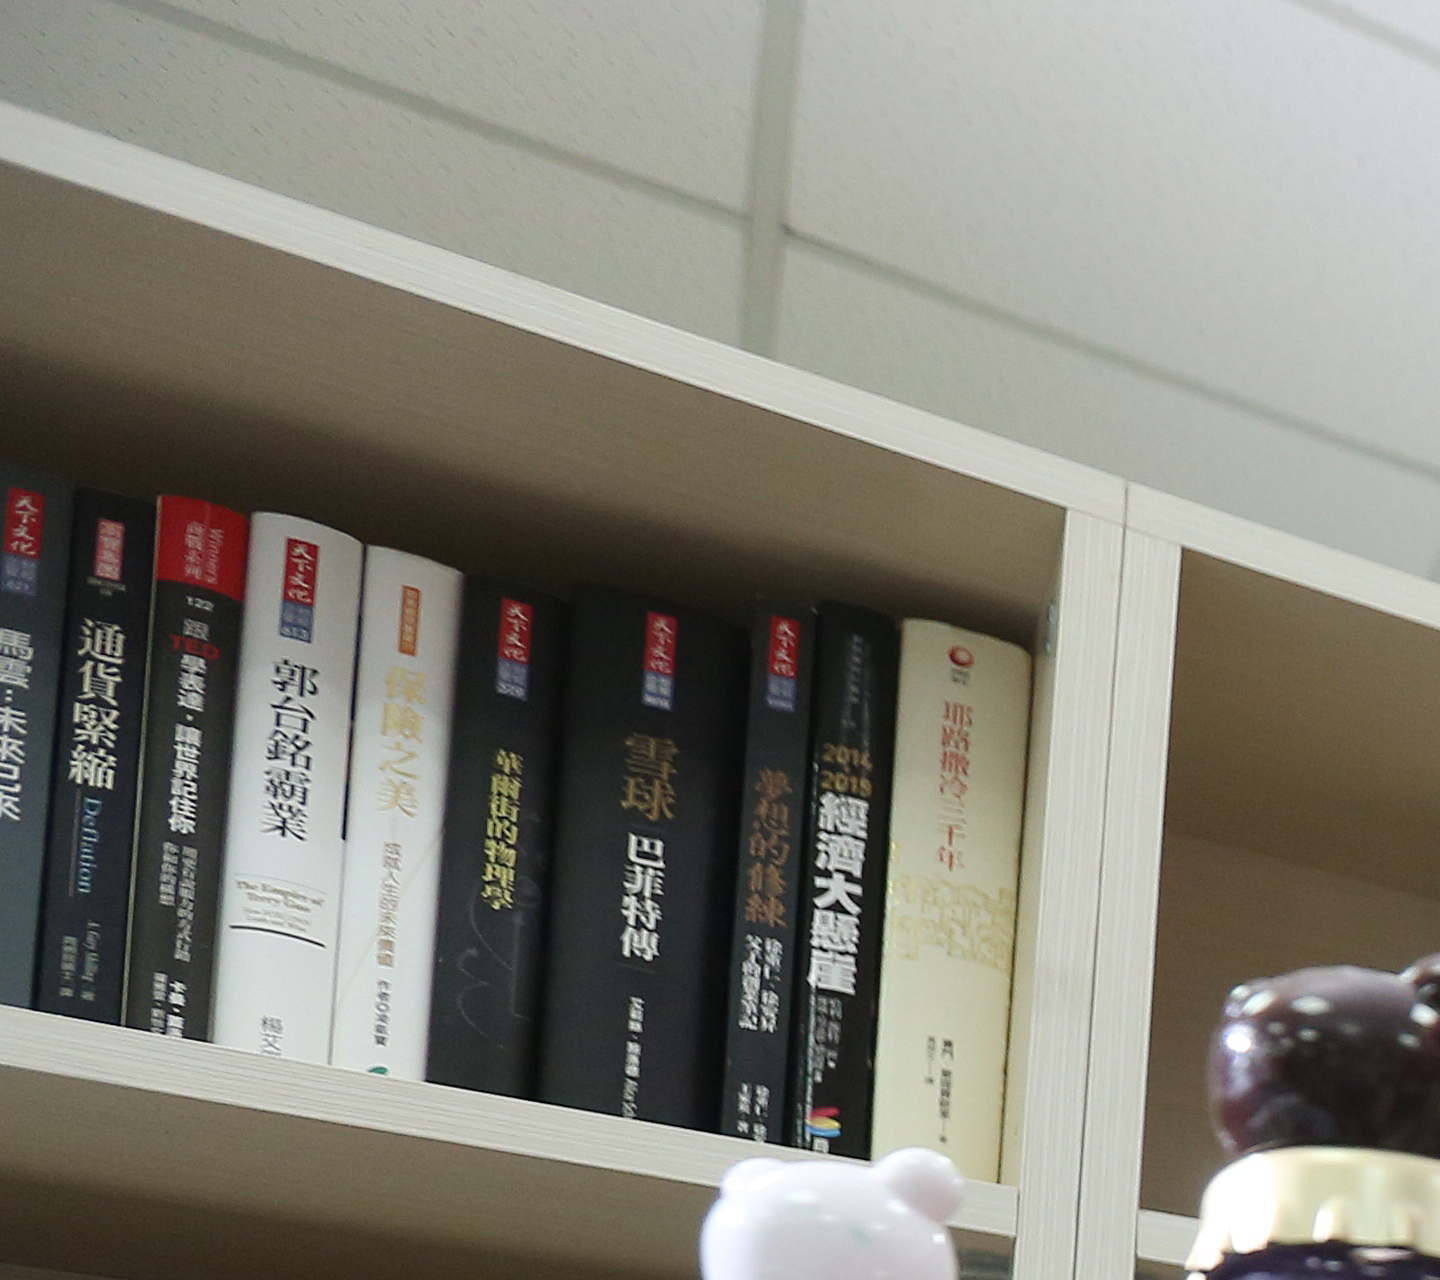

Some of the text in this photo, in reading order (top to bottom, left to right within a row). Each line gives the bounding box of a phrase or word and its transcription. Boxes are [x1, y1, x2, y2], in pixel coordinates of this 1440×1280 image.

[68, 617, 126, 790] 通貨緊縮
[169, 633, 220, 662] TED
[260, 658, 321, 842] 郭台銘霸業
[376, 666, 427, 819] 保險之美
[620, 733, 680, 822] 雪球
[937, 700, 974, 872] 耶路撒冷三千年
[77, 797, 102, 894] Deflation
[481, 749, 524, 911] 華爾街的物理學
[620, 832, 666, 963] 巴菲特傳
[806, 790, 870, 996] 經濟大懸崖
